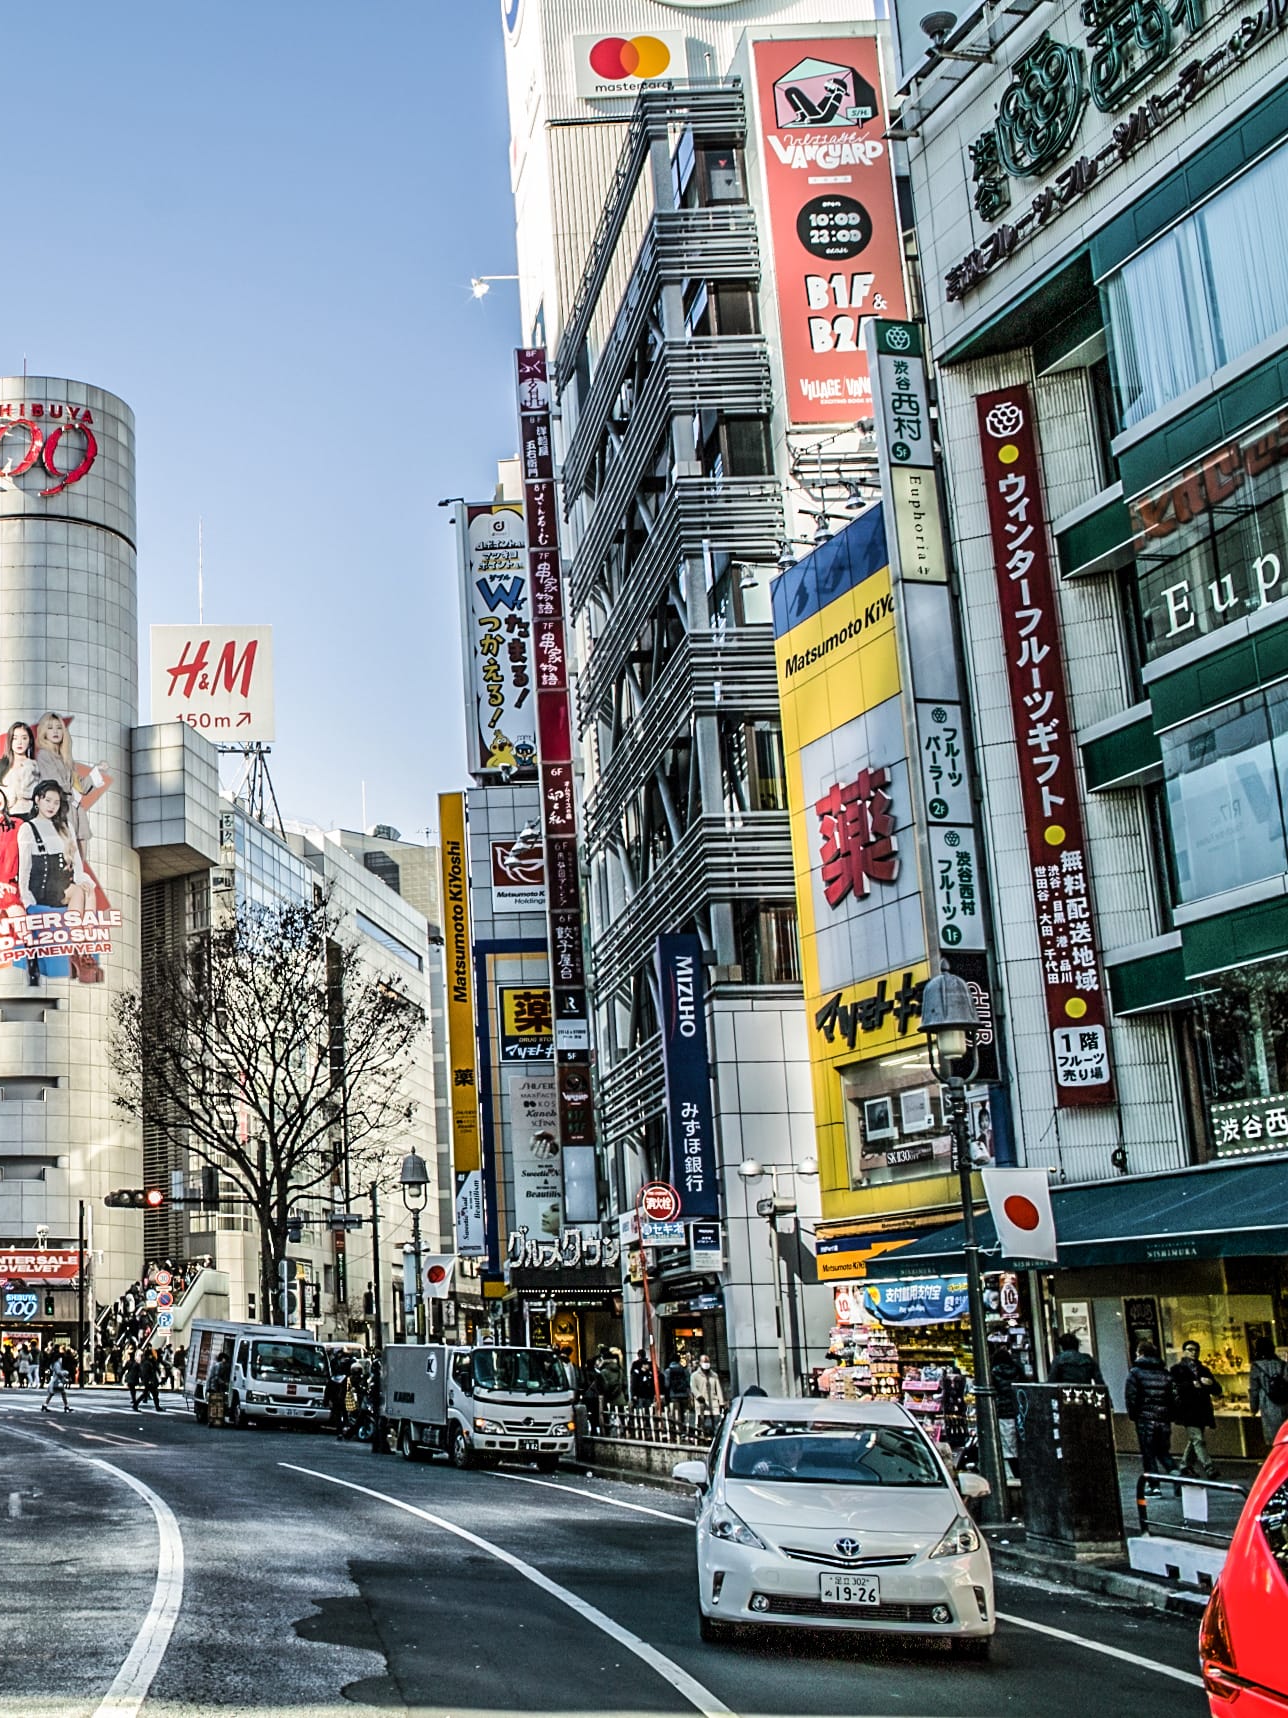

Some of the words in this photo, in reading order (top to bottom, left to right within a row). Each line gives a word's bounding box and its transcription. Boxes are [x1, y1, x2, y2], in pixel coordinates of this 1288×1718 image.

[767, 134, 885, 169] VANGUARD
[809, 212, 861, 227] 10:00
[809, 230, 863, 245] 23:00
[806, 273, 876, 310] B1F
[896, 447, 908, 459] 5F
[909, 475, 931, 562] Euphoria
[784, 618, 863, 679] Matsumoto
[998, 473, 1065, 818] ウィンターフルーツギフト
[166, 638, 259, 699] H&M
[941, 727, 963, 787] フルーツ
[550, 767, 563, 776] 6F
[933, 802, 947, 816] 2F
[814, 766, 901, 911] 薬
[446, 840, 464, 903] KiYoshi
[955, 850, 976, 917] 渋谷西村
[496, 890, 538, 899] Matsumoto
[937, 859, 957, 922] フルーツ
[63, 910, 122, 930] SALE
[1059, 849, 1100, 992] 無料配送地域
[70, 927, 110, 943] SUN
[944, 927, 959, 942] 1F
[37, 944, 76, 958] NEW
[76, 942, 112, 954] YEAR
[447, 905, 468, 1004] Matsumoto
[556, 926, 576, 979] 餃子屋台
[675, 955, 696, 1038] MIZUHO
[514, 991, 553, 1034] 薬
[1057, 1052, 1106, 1067] フルーツ
[453, 1068, 475, 1087] 薬
[1062, 1069, 1104, 1082] 売り場
[681, 1101, 705, 1193] みずほ銀行
[645, 1197, 672, 1210] 消火栓
[36, 1255, 79, 1265] SALE
[508, 1227, 621, 1269] グルメタウン
[4, 1300, 38, 1322] 109
[835, 1585, 877, 1603] 19-26
[851, 1577, 866, 1586] 302
